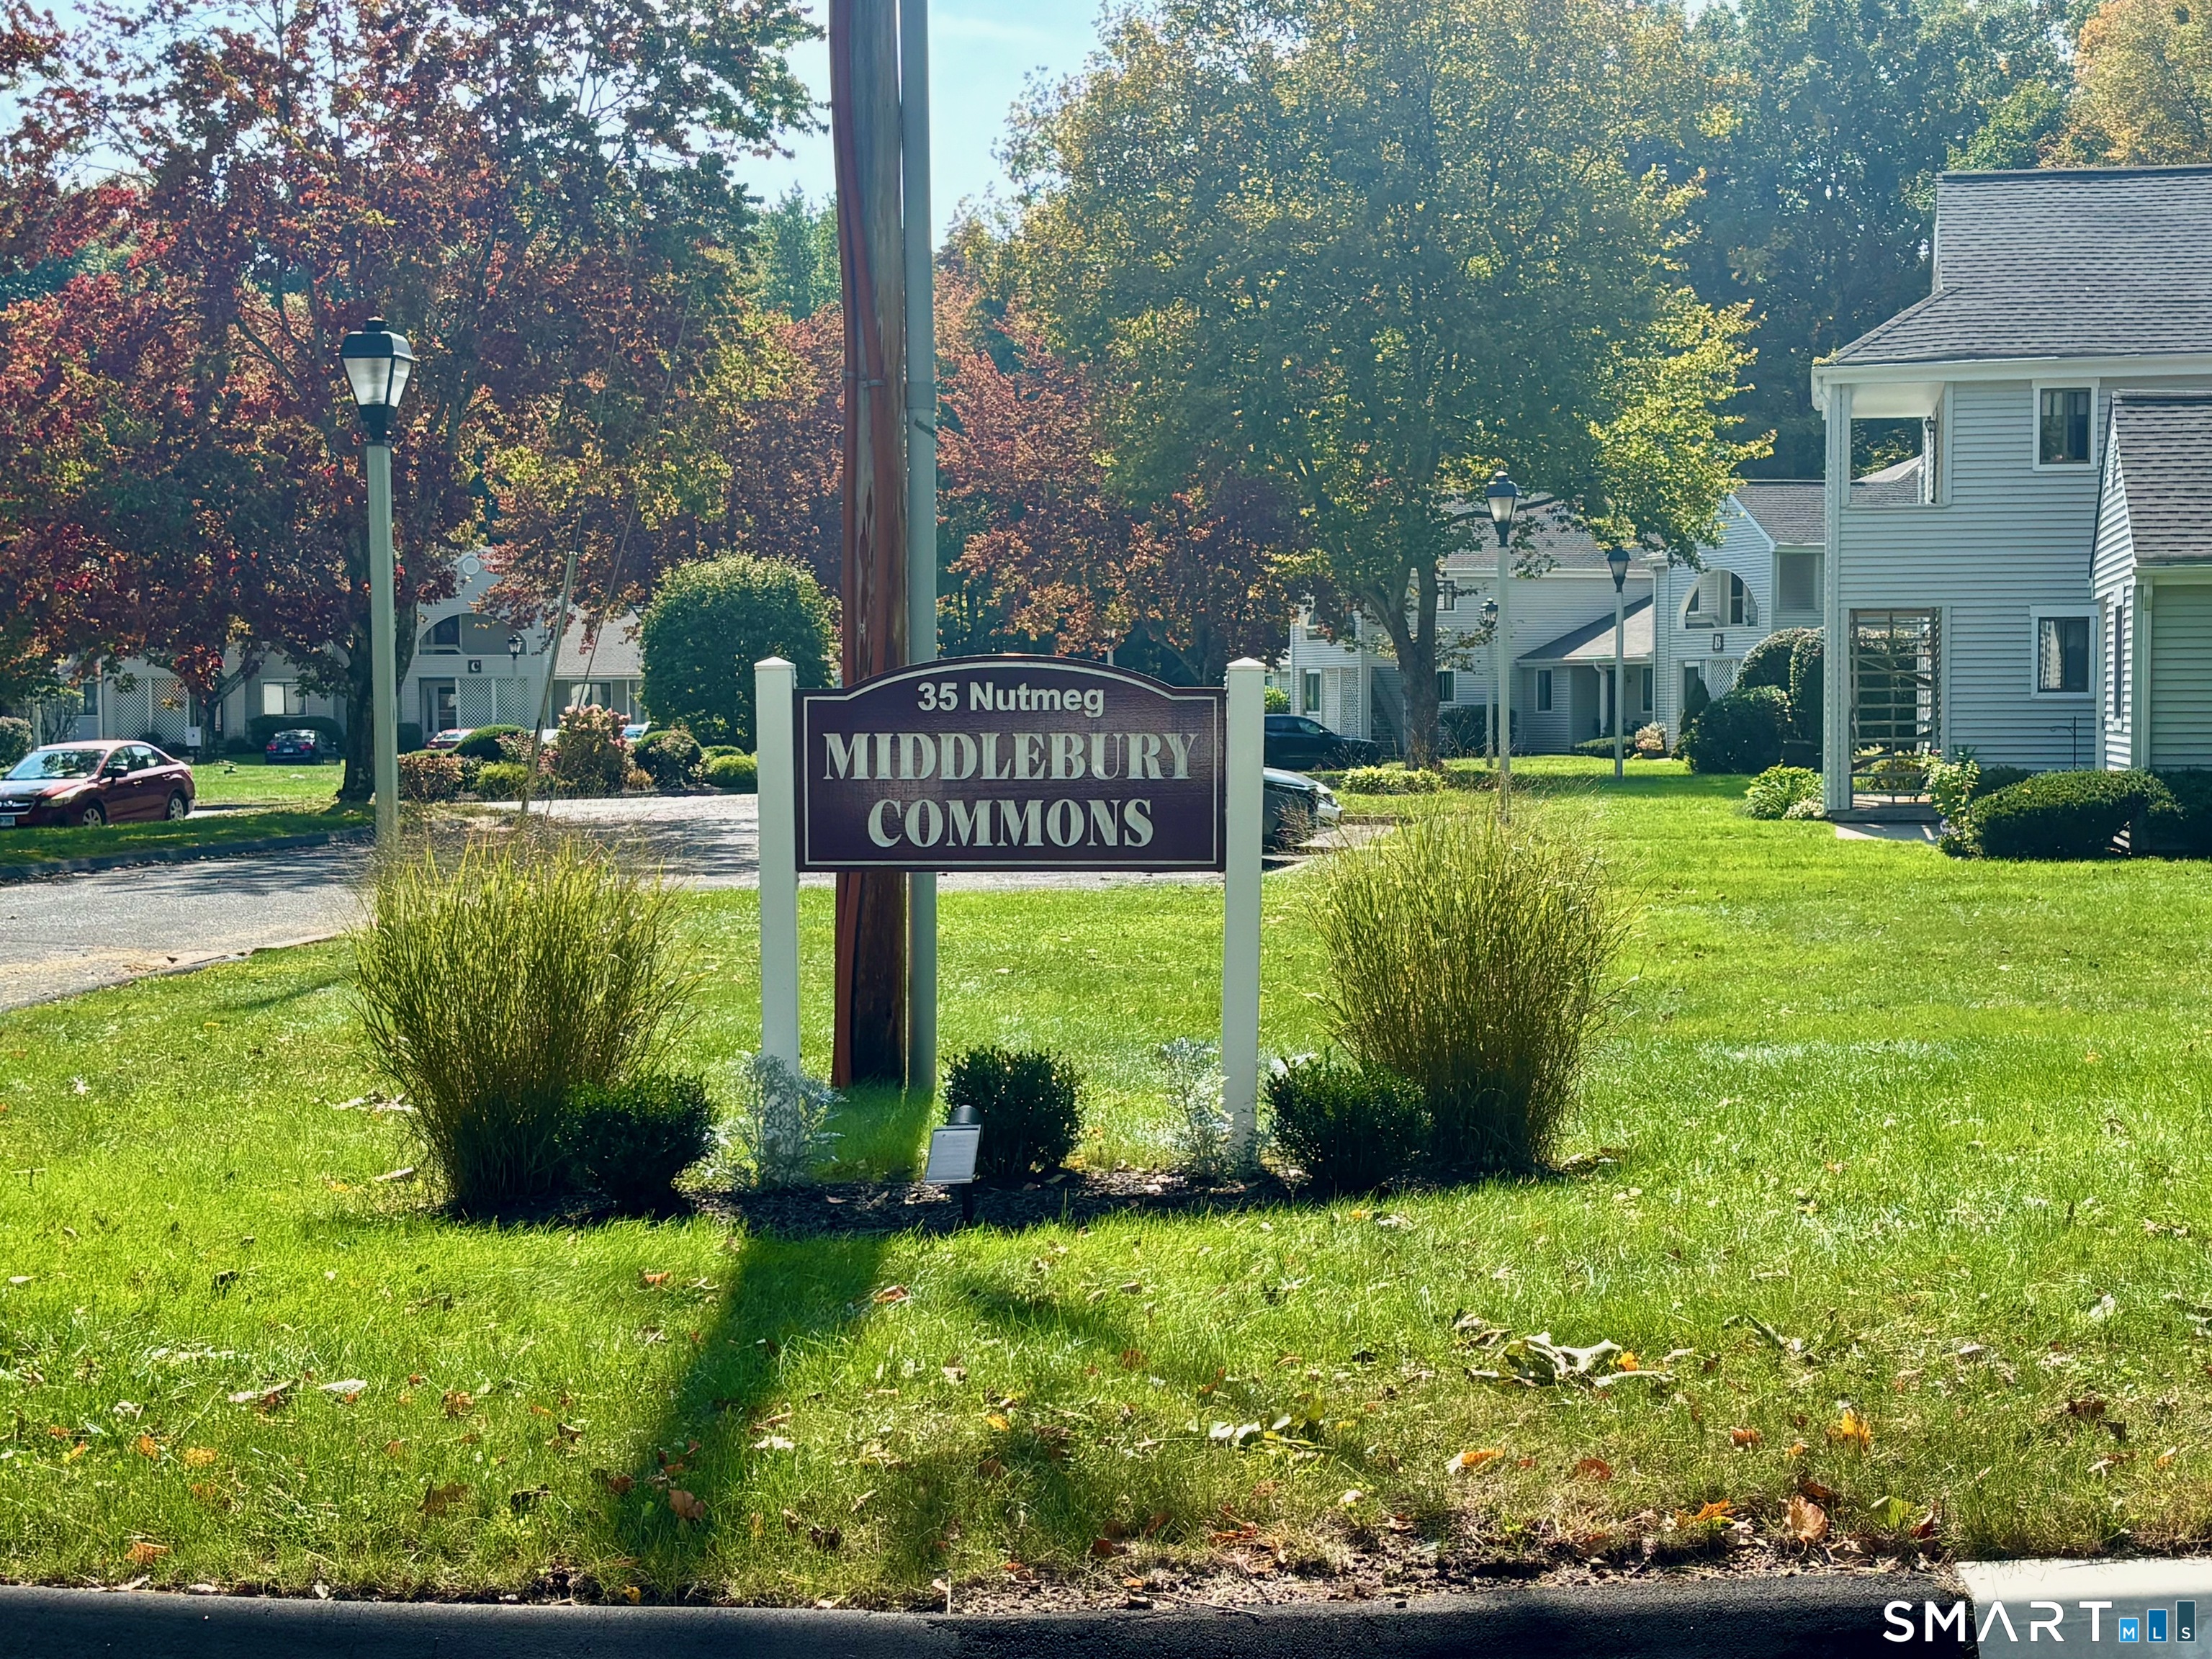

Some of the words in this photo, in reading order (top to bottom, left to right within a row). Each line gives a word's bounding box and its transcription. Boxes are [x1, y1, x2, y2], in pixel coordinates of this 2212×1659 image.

[1714, 635, 1721, 649] B
[471, 662, 479, 671] C
[917, 682, 958, 711] 35
[970, 682, 1105, 717] Nutmeg
[822, 732, 1198, 781] MIDDLEBURY
[868, 799, 1154, 848] COMMONS
